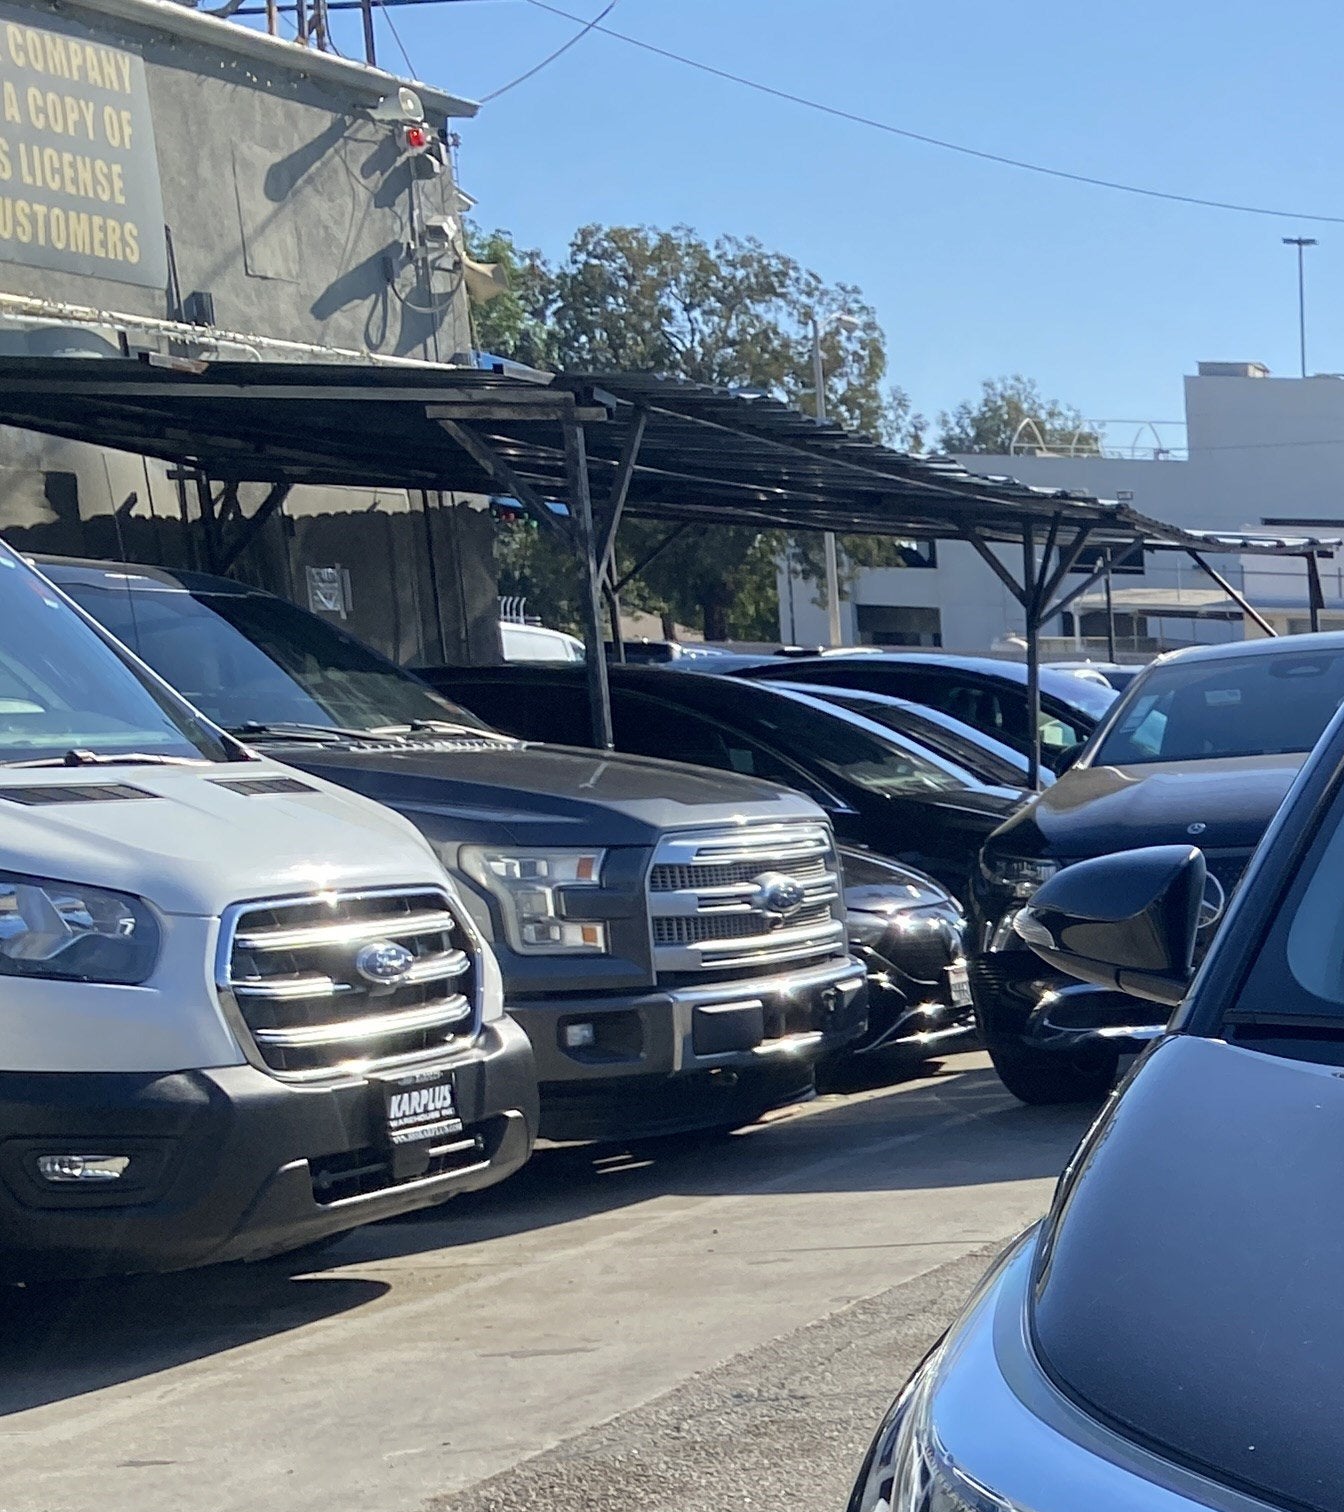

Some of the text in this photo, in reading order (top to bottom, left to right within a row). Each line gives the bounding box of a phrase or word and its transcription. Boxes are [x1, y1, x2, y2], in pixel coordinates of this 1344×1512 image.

[6, 24, 131, 94] COMPANY
[3, 81, 133, 149] A COPY OF
[19, 143, 126, 205] LICENSE
[390, 1084, 452, 1119] KARPLUS
